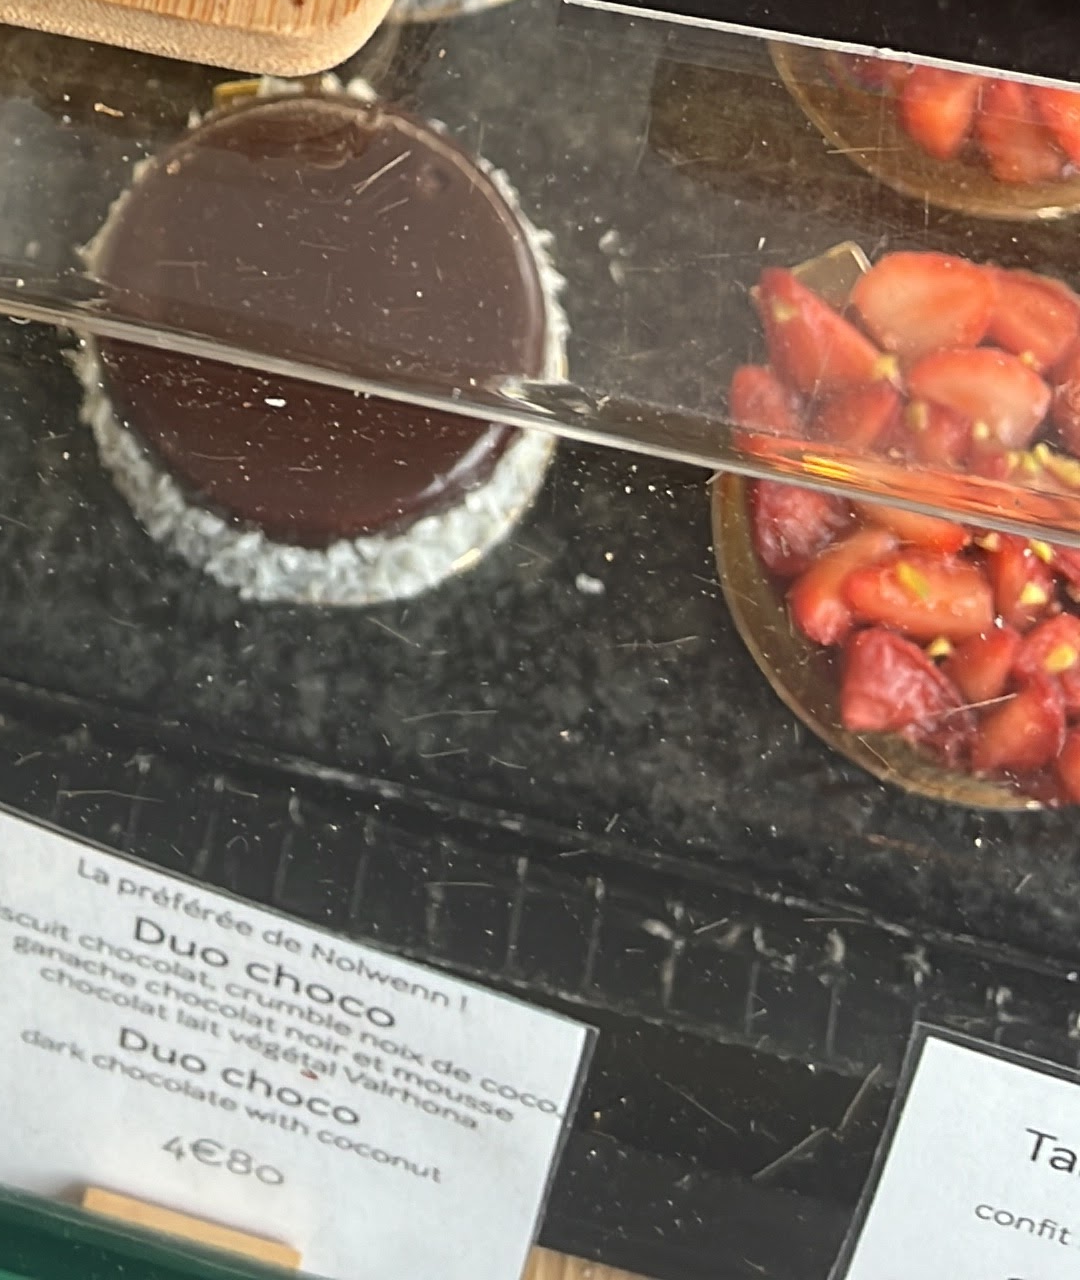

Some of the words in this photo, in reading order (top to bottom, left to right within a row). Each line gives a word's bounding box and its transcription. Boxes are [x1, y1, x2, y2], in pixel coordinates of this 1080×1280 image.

[77, 856, 110, 886] La
[117, 877, 254, 937] préférée
[262, 928, 302, 954] de
[311, 942, 450, 1009] Nolwenn
[134, 916, 229, 968] Duo
[246, 962, 395, 1027] choco
[13, 935, 137, 988] ganache
[144, 980, 278, 1034] chocolat
[285, 1024, 348, 1057] noir
[352, 1049, 384, 1073] et
[392, 1066, 514, 1123] mousse
[39, 966, 169, 1021] chocolat
[176, 1008, 220, 1038] lait
[229, 1028, 336, 1077] végétal
[343, 1064, 479, 1130] Valrhona
[78, 934, 216, 991] chocolat,
[225, 981, 352, 1036] crumble
[360, 1030, 423, 1067] noix
[431, 1057, 472, 1084] de
[480, 1077, 563, 1119] coco,
[119, 1026, 207, 1074] Duo
[221, 1065, 360, 1125] choco
[20, 1028, 86, 1063] dark
[91, 1053, 238, 1112] chocolate
[245, 1104, 310, 1138] with
[316, 1129, 442, 1184] coconut
[160, 1136, 285, 1187] 4€80
[1025, 1128, 1080, 1174] Ta
[974, 1204, 1071, 1246] confit
